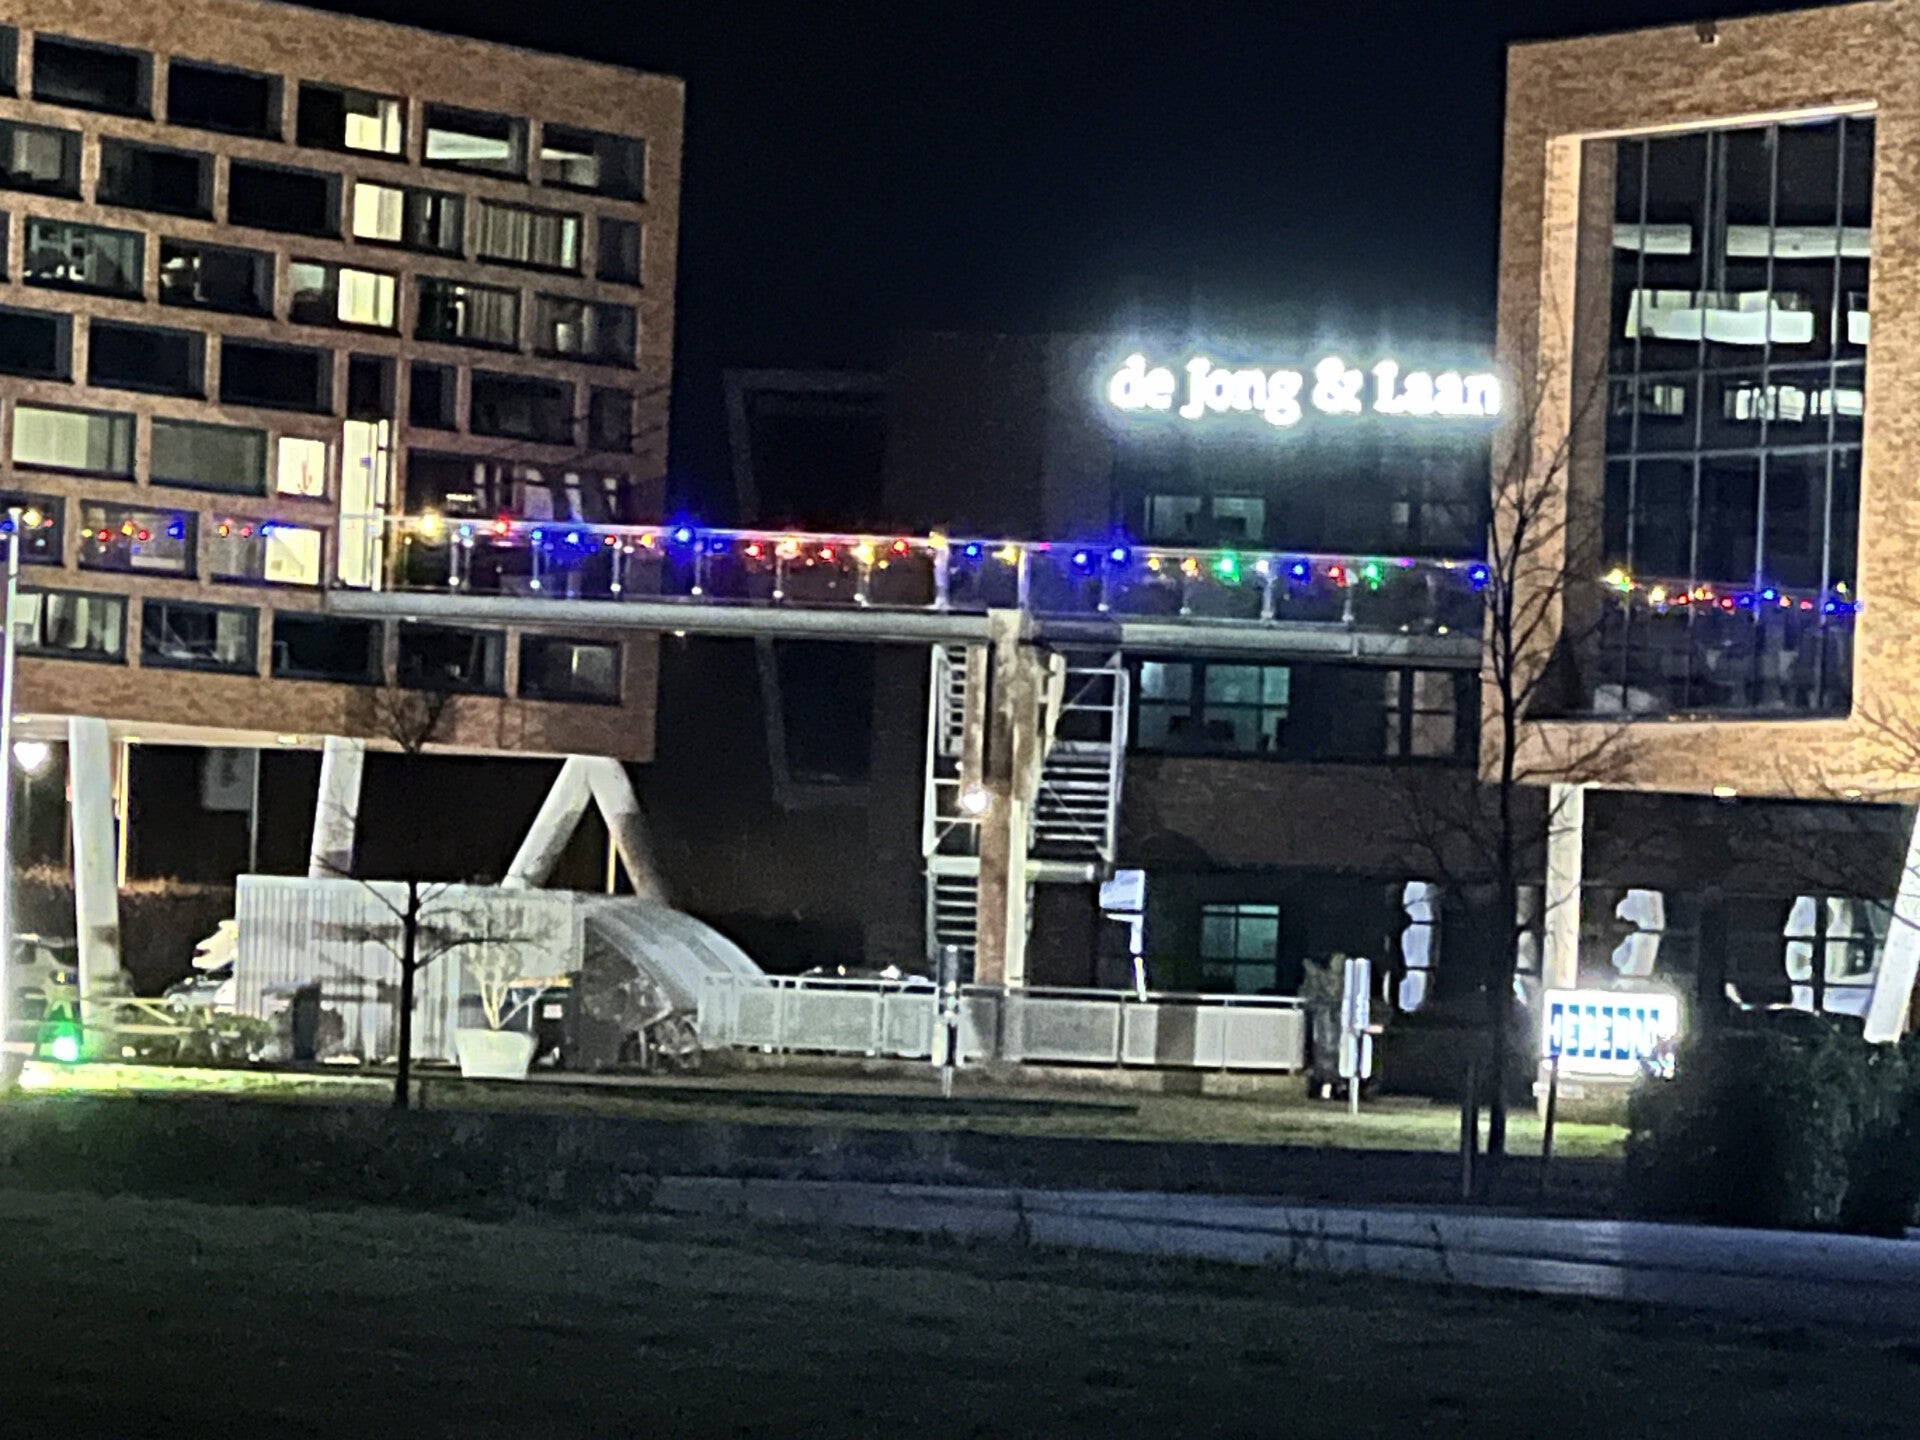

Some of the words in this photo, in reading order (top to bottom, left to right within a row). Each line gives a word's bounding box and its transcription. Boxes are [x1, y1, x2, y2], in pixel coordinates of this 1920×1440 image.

[1110, 353, 1175, 409] de
[1312, 356, 1363, 413] &
[1373, 360, 1501, 416] Laan
